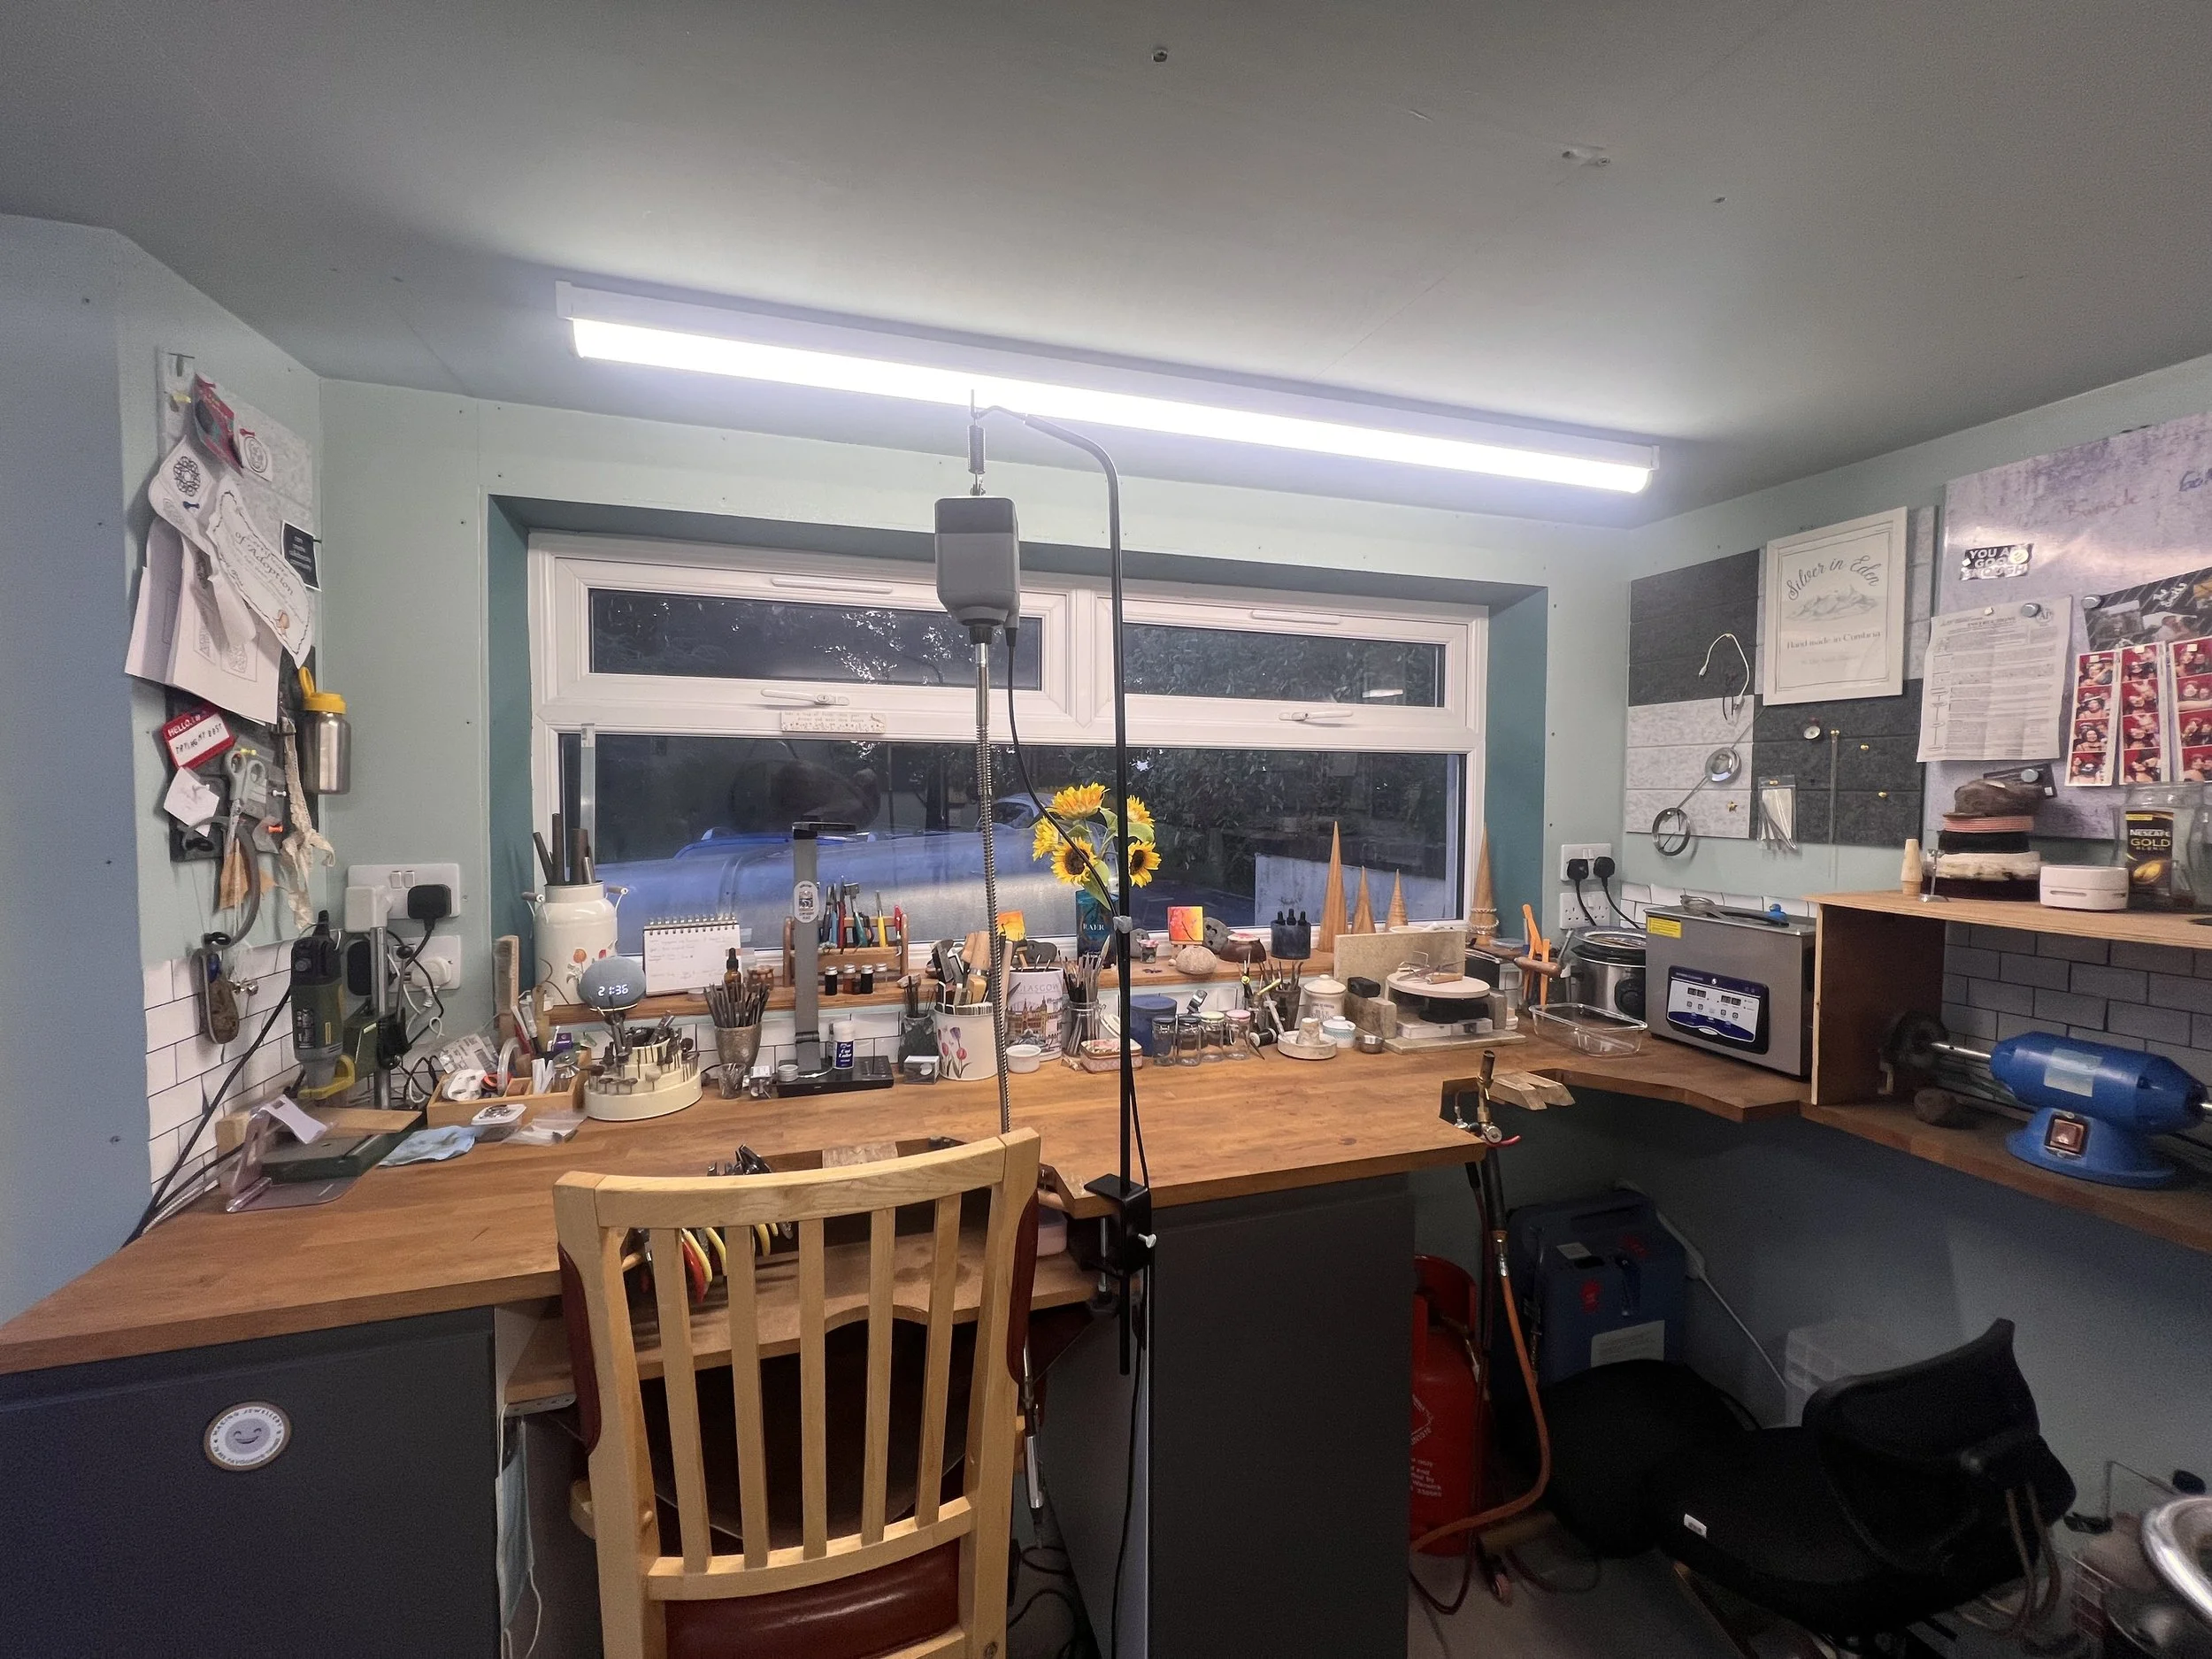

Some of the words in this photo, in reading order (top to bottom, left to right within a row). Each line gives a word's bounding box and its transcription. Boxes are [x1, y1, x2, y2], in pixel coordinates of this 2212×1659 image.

[1970, 549, 1998, 559] YOU
[1974, 557, 2008, 568] GOO
[248, 542, 294, 596] Adoption
[1786, 563, 1824, 601] Silver
[1830, 558, 1844, 572] in
[1850, 555, 1882, 587] Eden
[1843, 632, 1881, 641] Cumbria
[2131, 838, 2171, 847] GOLD
[597, 984, 629, 996] 21:36
